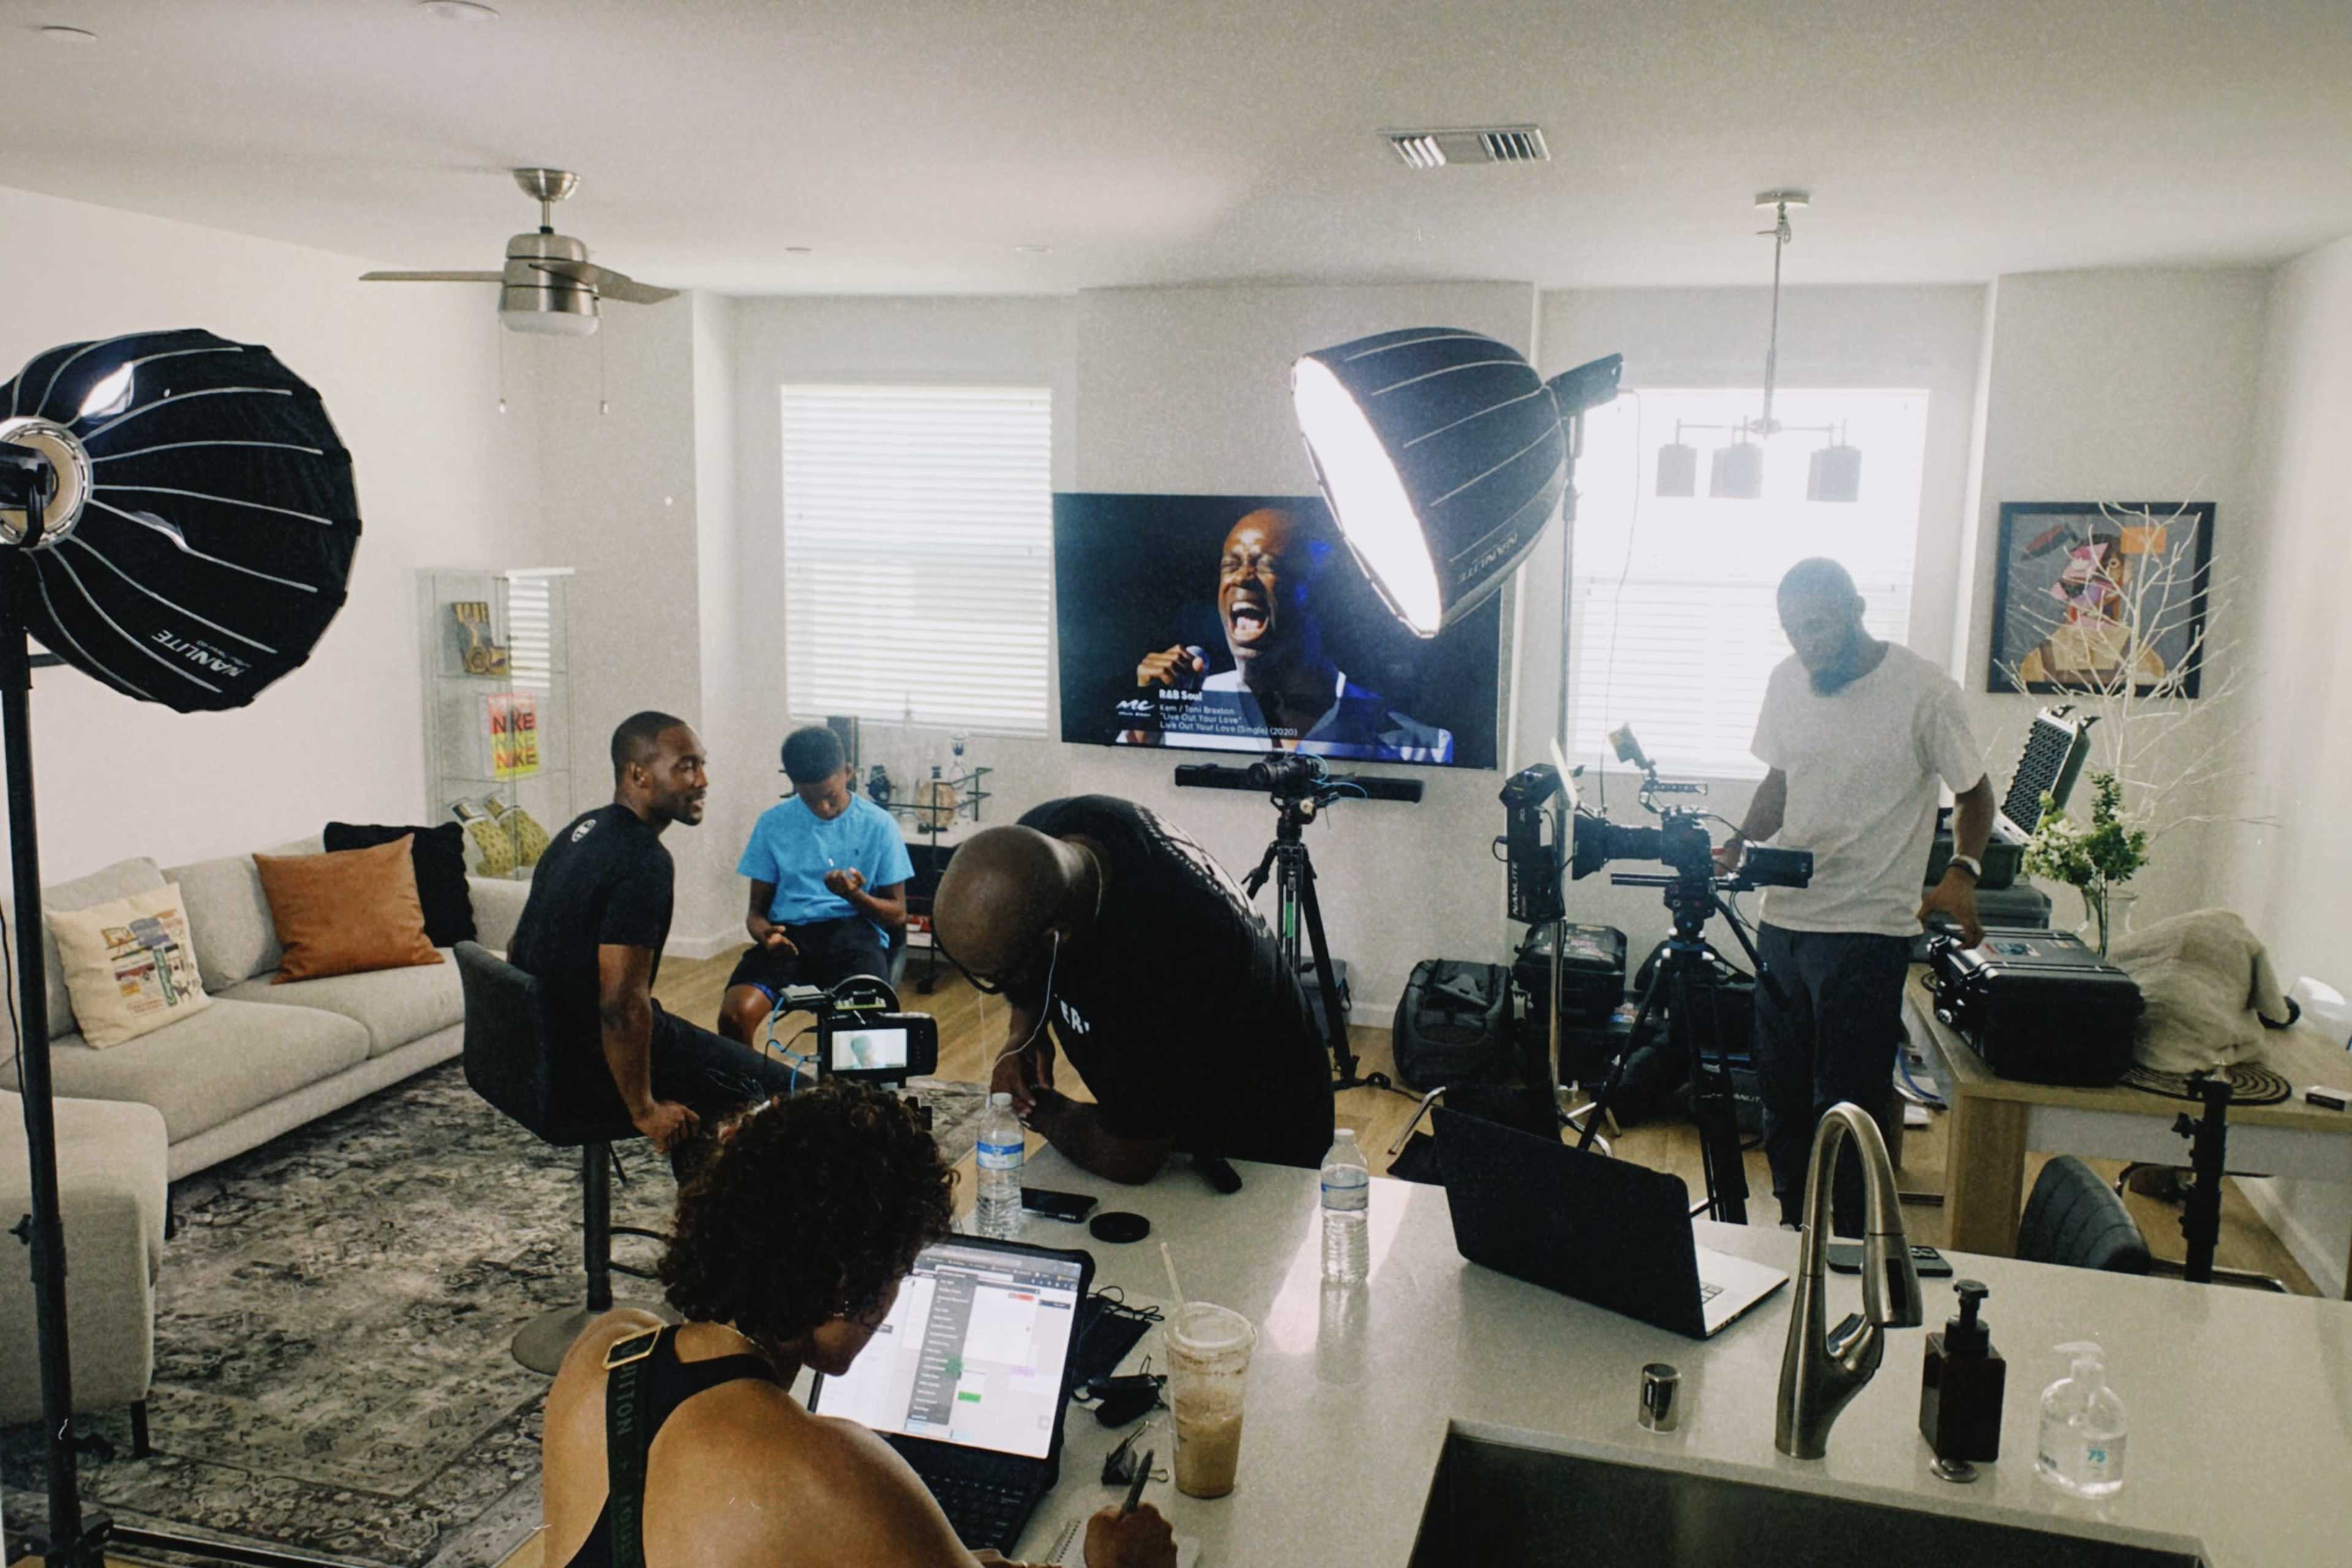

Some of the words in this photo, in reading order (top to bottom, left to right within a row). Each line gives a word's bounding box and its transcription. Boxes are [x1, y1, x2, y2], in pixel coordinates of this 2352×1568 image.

[151, 629, 245, 677] NANLITE
[1159, 688, 1180, 699] R&B
[1181, 690, 1202, 701] Soul
[1203, 706, 1235, 715] Braxton
[1181, 713, 1196, 722] Out
[1197, 714, 1217, 723] Your
[1178, 722, 1194, 731] Out
[1215, 723, 1236, 733] Love
[1270, 726, 1298, 737] (2020)
